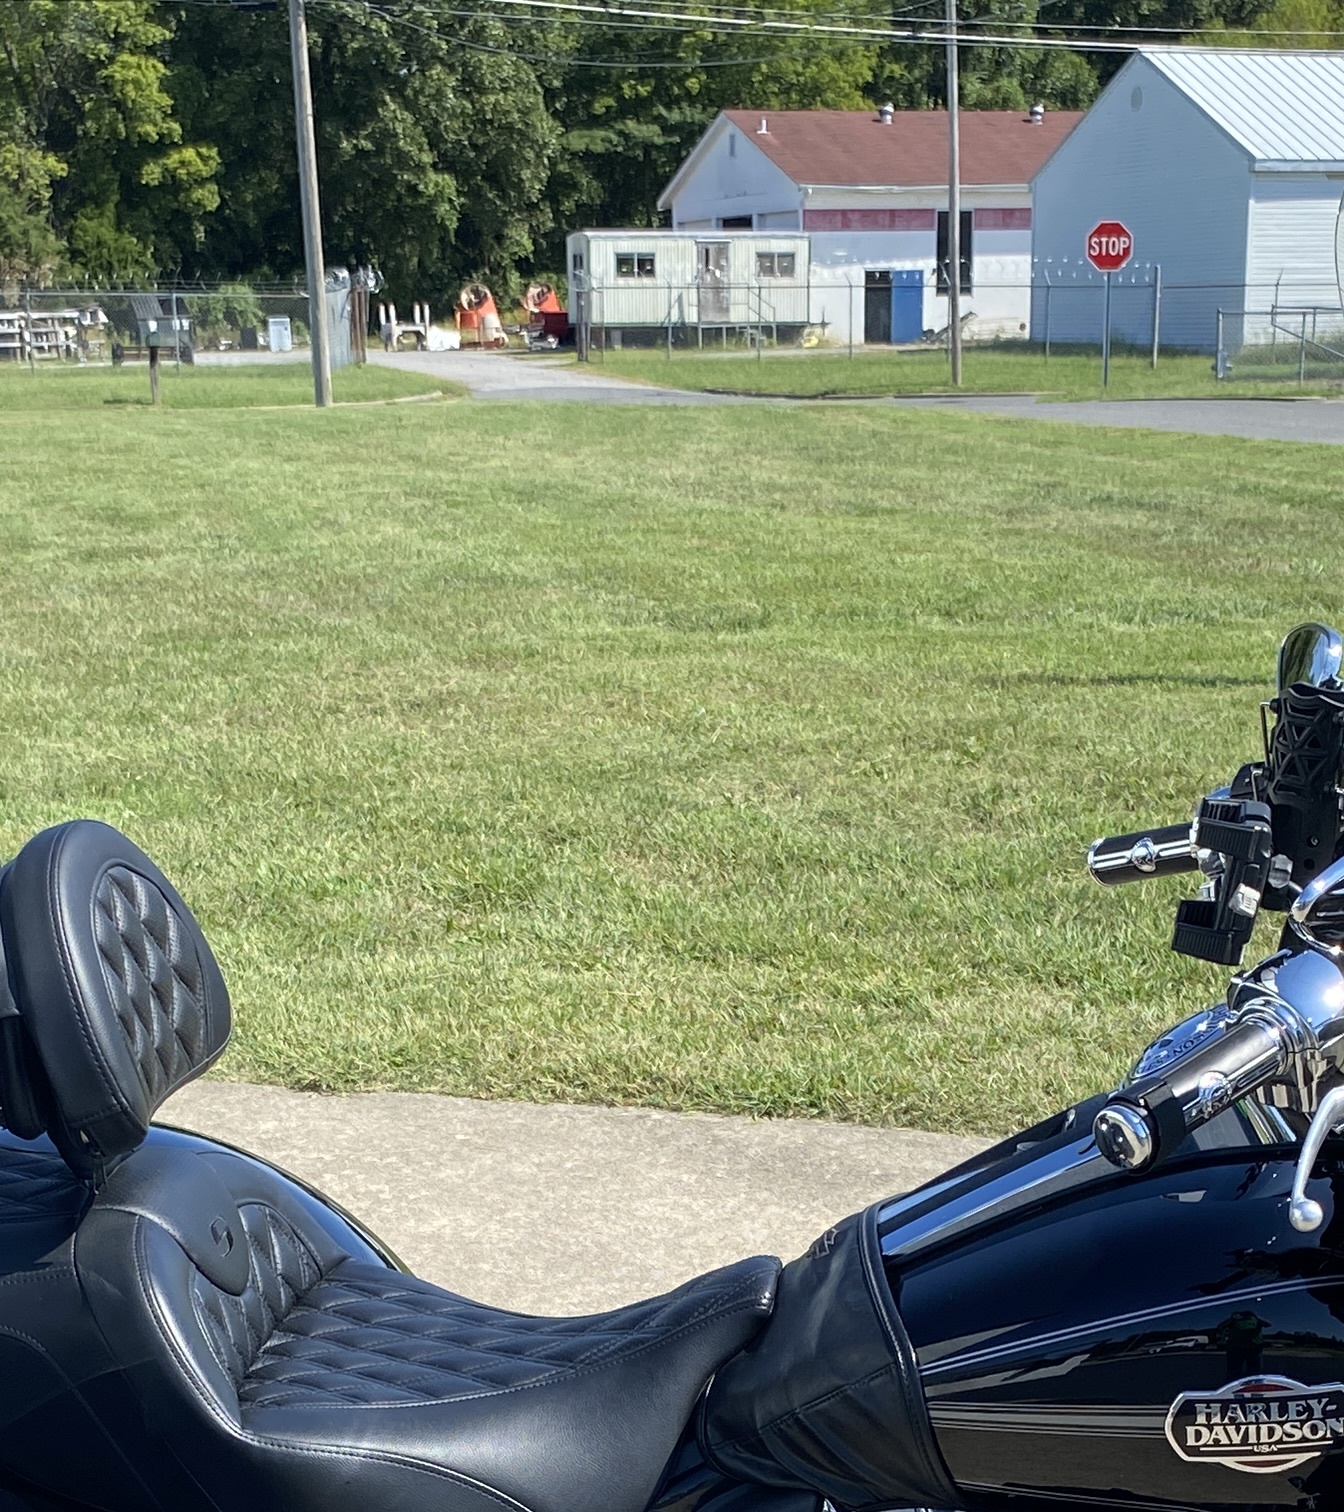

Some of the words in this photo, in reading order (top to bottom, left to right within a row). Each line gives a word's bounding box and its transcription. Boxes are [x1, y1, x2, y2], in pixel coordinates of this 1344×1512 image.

[1089, 236, 1130, 256] STOP
[1194, 1398, 1338, 1425] HARLEY-
[1252, 1444, 1278, 1453] USA
